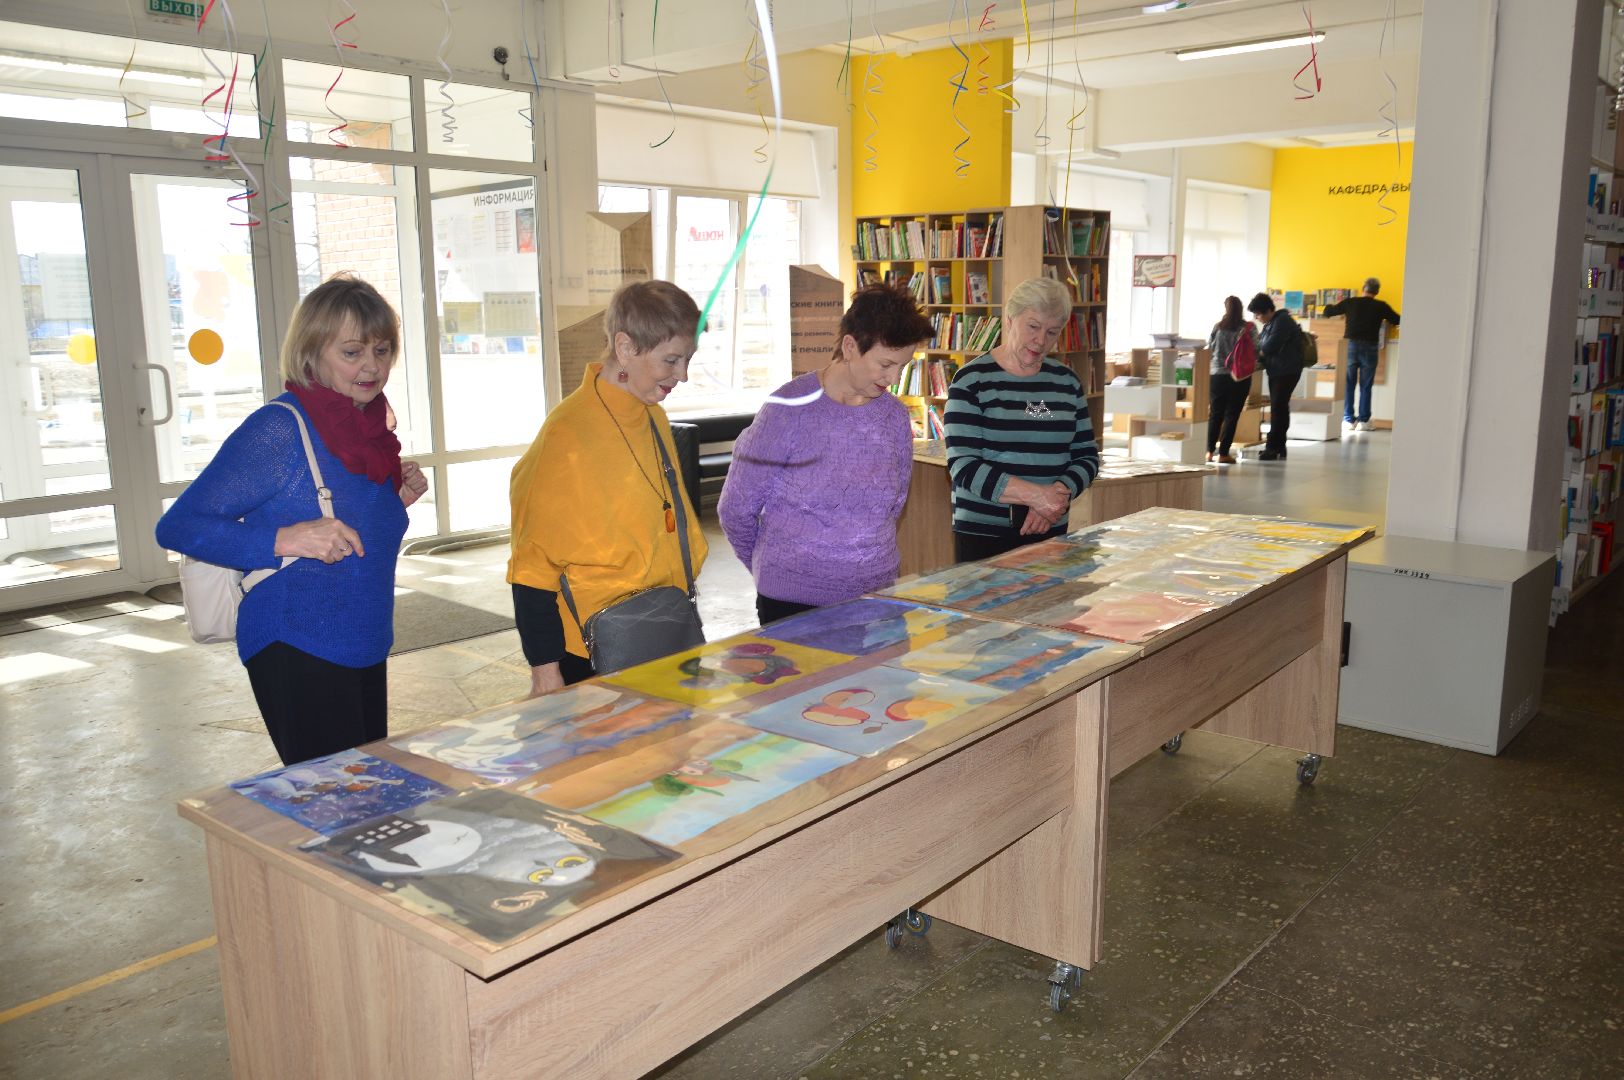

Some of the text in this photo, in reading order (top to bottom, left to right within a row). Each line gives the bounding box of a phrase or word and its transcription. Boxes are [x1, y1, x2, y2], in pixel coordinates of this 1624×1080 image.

[152, 0, 202, 17] ВЫХОД
[474, 189, 534, 207] ИНФОРМАЦИЯ
[1328, 184, 1387, 195] КАФЕДРА
